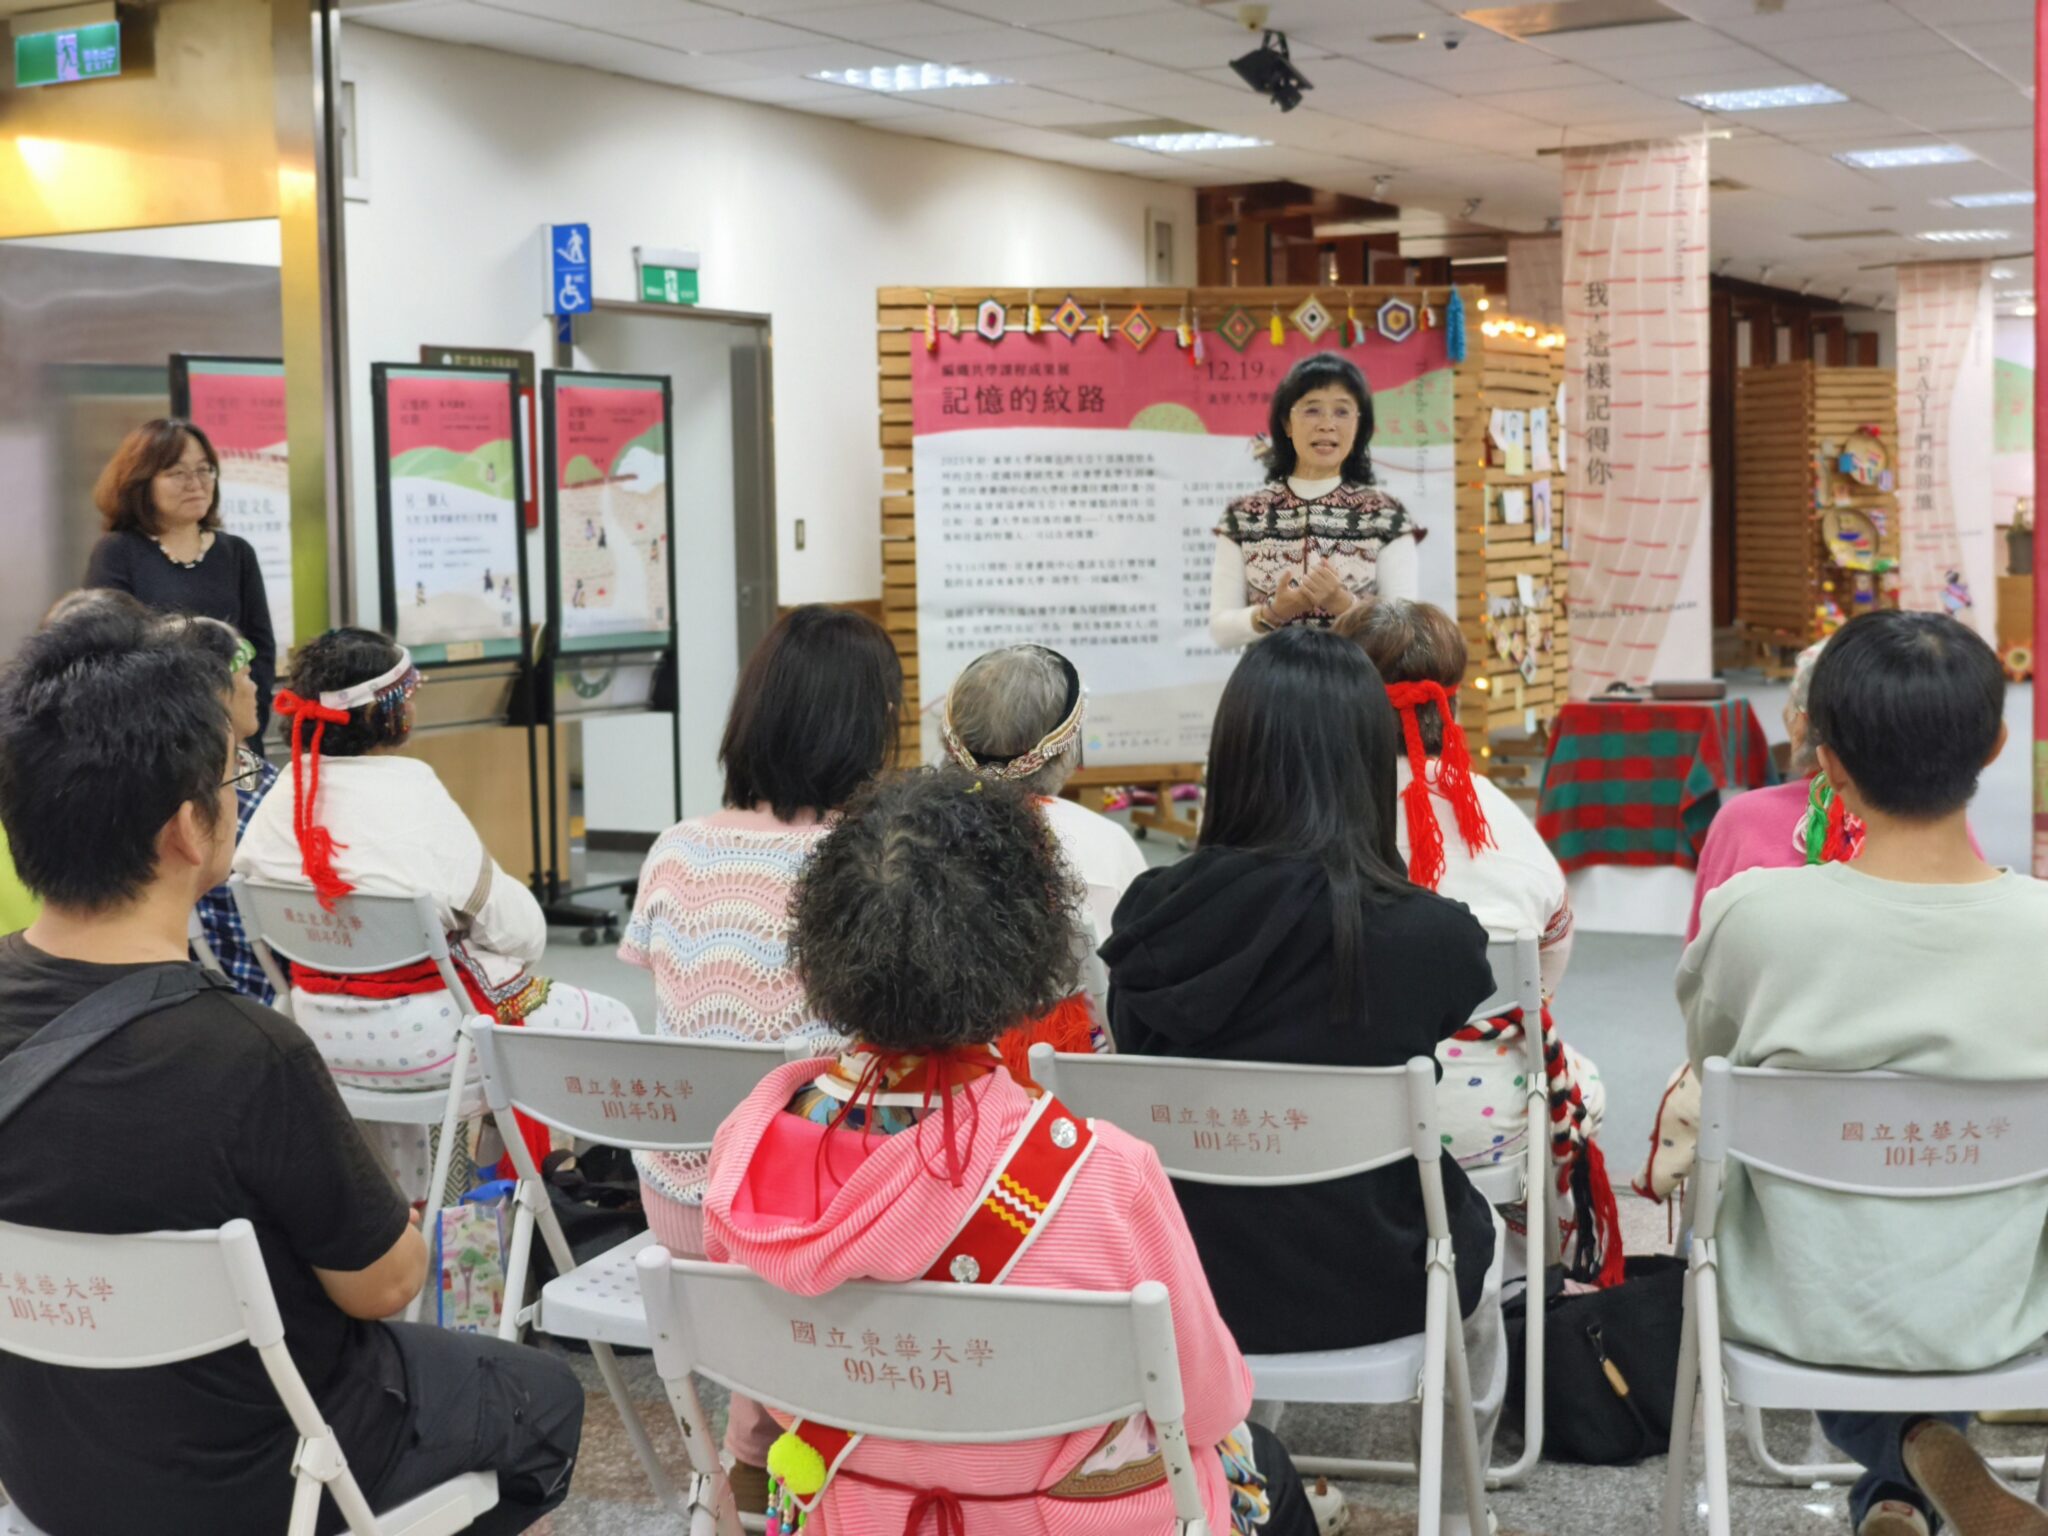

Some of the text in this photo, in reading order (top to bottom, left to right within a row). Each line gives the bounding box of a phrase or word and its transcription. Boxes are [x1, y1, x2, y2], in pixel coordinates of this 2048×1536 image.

[1207, 361, 1264, 381] 12.19
[941, 384, 1104, 415] 記憶的紋路
[601, 1099, 677, 1122] 101年5月
[1193, 1130, 1281, 1154] 101年5月
[1884, 1144, 1981, 1167] 101年5月
[790, 1319, 994, 1367] 國立東華大學
[843, 1357, 953, 1396] 99年6月
